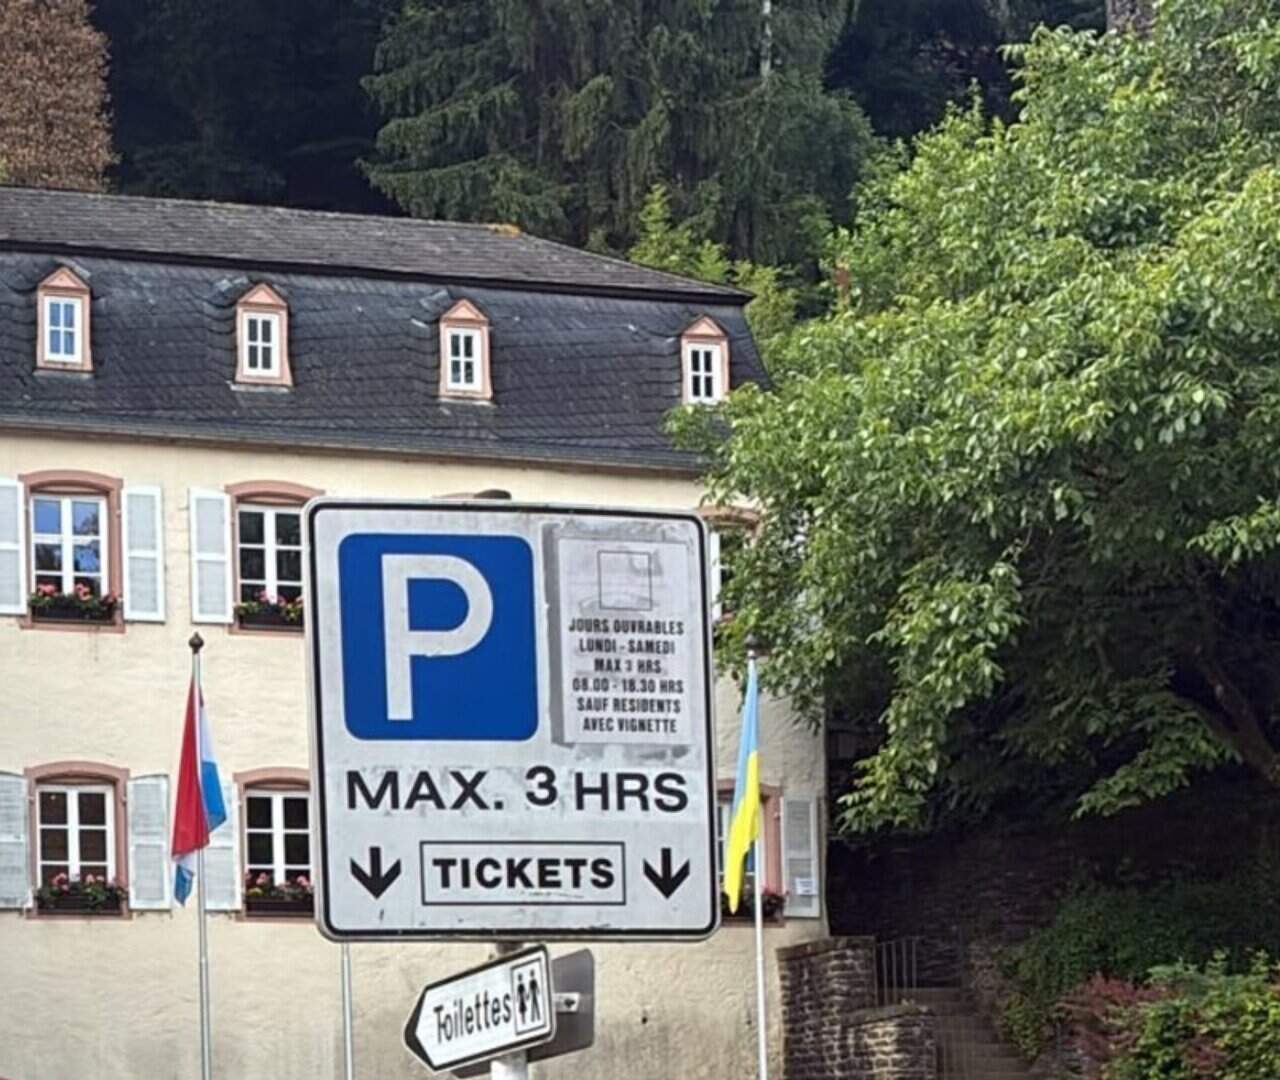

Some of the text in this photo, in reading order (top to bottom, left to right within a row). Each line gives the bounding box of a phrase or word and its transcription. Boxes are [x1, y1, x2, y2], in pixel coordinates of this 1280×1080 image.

[568, 618, 685, 635] JOURS OUVRABLES
[381, 553, 494, 721] P
[579, 638, 617, 653] LUNDI
[628, 639, 676, 655] SAMEDI
[594, 658, 622, 673] MAX
[637, 659, 662, 674] HRS
[572, 678, 610, 692] 08.00
[622, 678, 657, 693] 18.30
[659, 680, 684, 694] HRS
[577, 697, 681, 714] SAUF RESIDENTS
[583, 718, 677, 733] AVEC VIGNETTE
[347, 765, 689, 813] MAX. 3 HRS
[432, 858, 615, 890] TICKETS
[433, 991, 512, 1045] Toilettes
